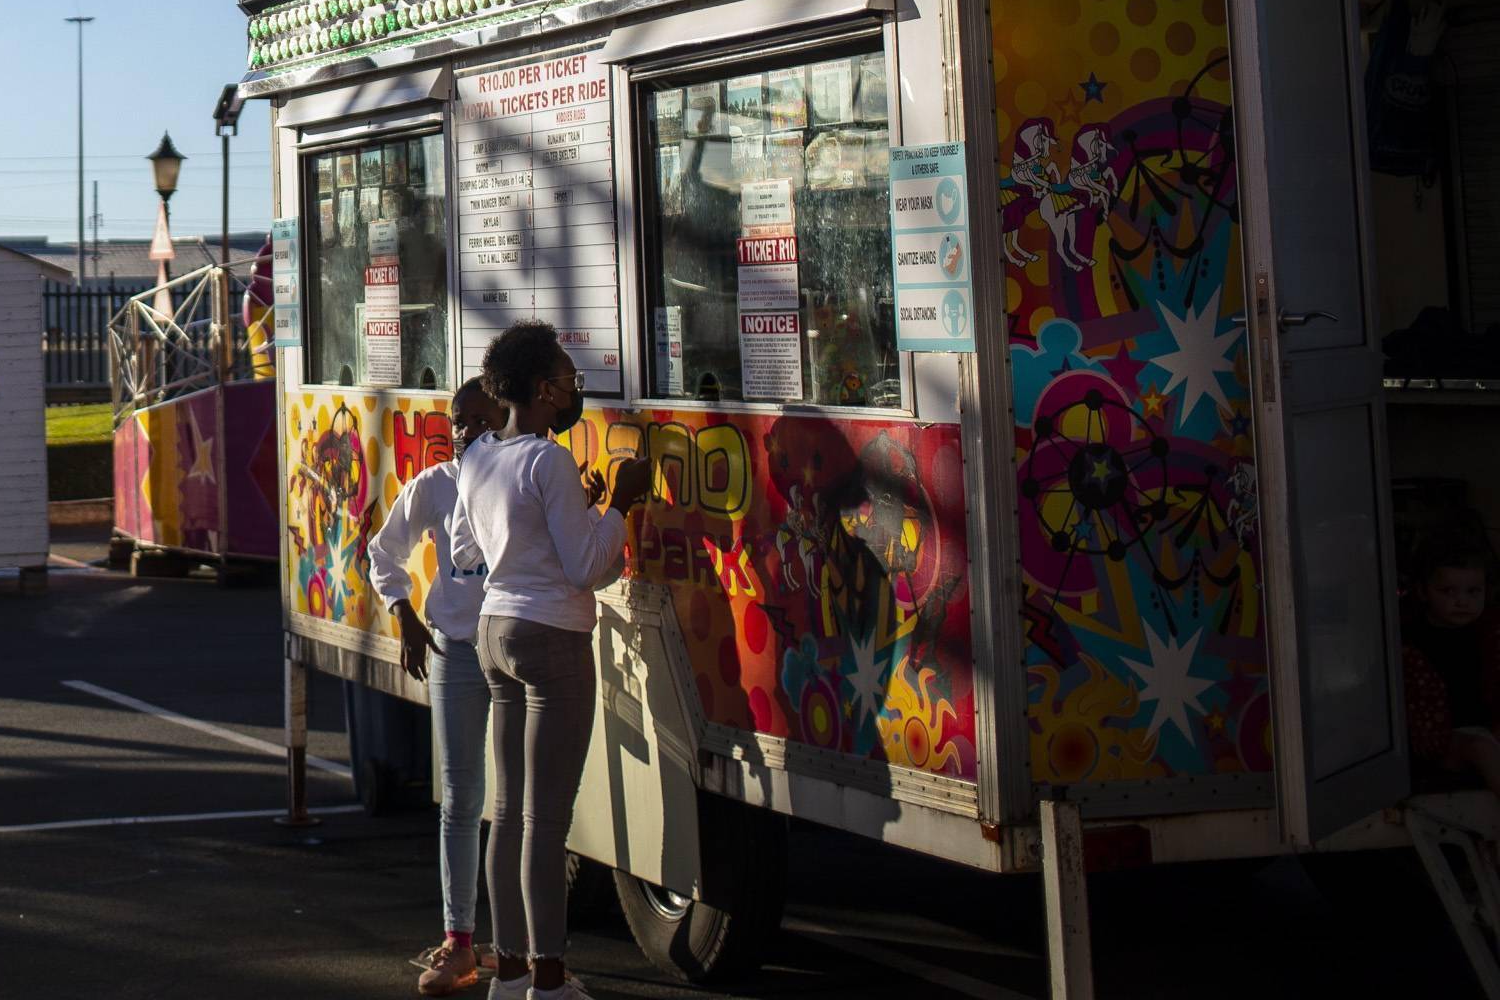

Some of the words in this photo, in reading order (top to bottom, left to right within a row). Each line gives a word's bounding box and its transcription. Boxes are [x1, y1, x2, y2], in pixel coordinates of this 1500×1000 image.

[479, 70, 515, 94] R10.00
[518, 65, 541, 86] PER
[544, 55, 587, 81] TICKET
[463, 101, 497, 121] TOTAL
[500, 90, 549, 116] TICKETS
[552, 85, 575, 107] PER
[578, 78, 607, 102] RIDE
[547, 132, 567, 146] RUNAWAY
[567, 129, 581, 142] TRAIN
[558, 147, 577, 161] SKELTER
[940, 144, 959, 157] YOURSELF
[895, 198, 908, 212] WEAR
[908, 196, 920, 211] YOUR
[920, 195, 934, 210] MASK
[483, 216, 500, 228] SKYLAB
[468, 237, 483, 249] FERRIS
[483, 236, 497, 248] WHEEL
[745, 239, 777, 262] TICKET
[779, 238, 796, 261] R10
[898, 251, 919, 266] SANITIZE
[919, 250, 937, 265] HANDS
[369, 267, 388, 284] TICKET
[388, 266, 399, 283] R10
[900, 307, 914, 321] SOCIAL
[913, 306, 937, 321] DISTANCING
[369, 322, 398, 335] NOTICE
[745, 315, 796, 334] NOTICE
[573, 331, 590, 344] STALLS
[603, 353, 617, 366] CASH
